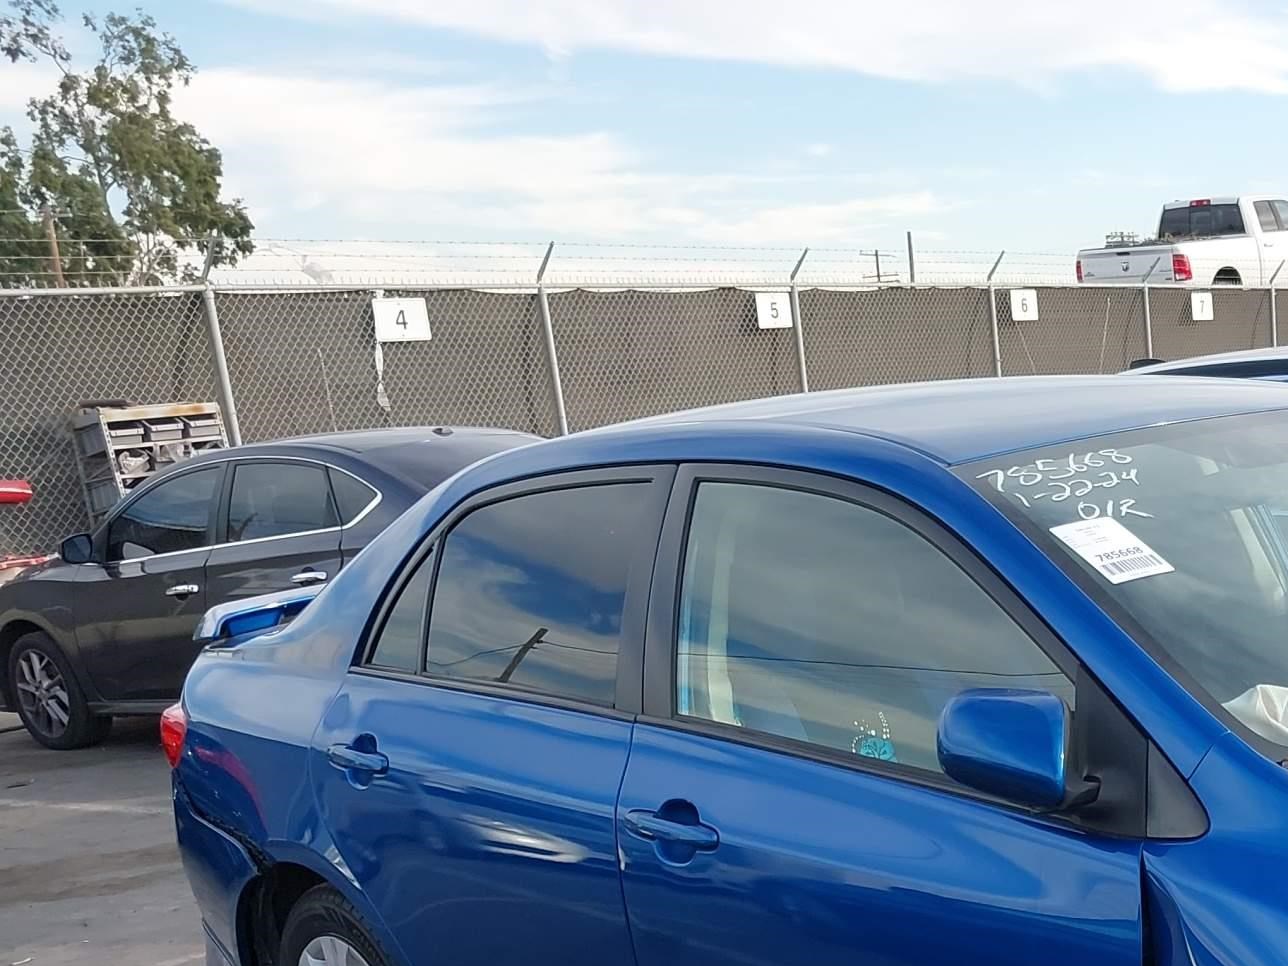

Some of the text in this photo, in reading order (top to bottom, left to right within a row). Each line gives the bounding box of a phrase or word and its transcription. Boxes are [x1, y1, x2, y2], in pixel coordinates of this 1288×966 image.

[770, 302, 779, 319] 5
[1021, 297, 1028, 313] 6
[1199, 300, 1205, 313] 7
[395, 309, 409, 330] 4
[976, 449, 1133, 493] 785668
[1014, 468, 1140, 508] 1-22-24
[1094, 546, 1144, 562] 785668
